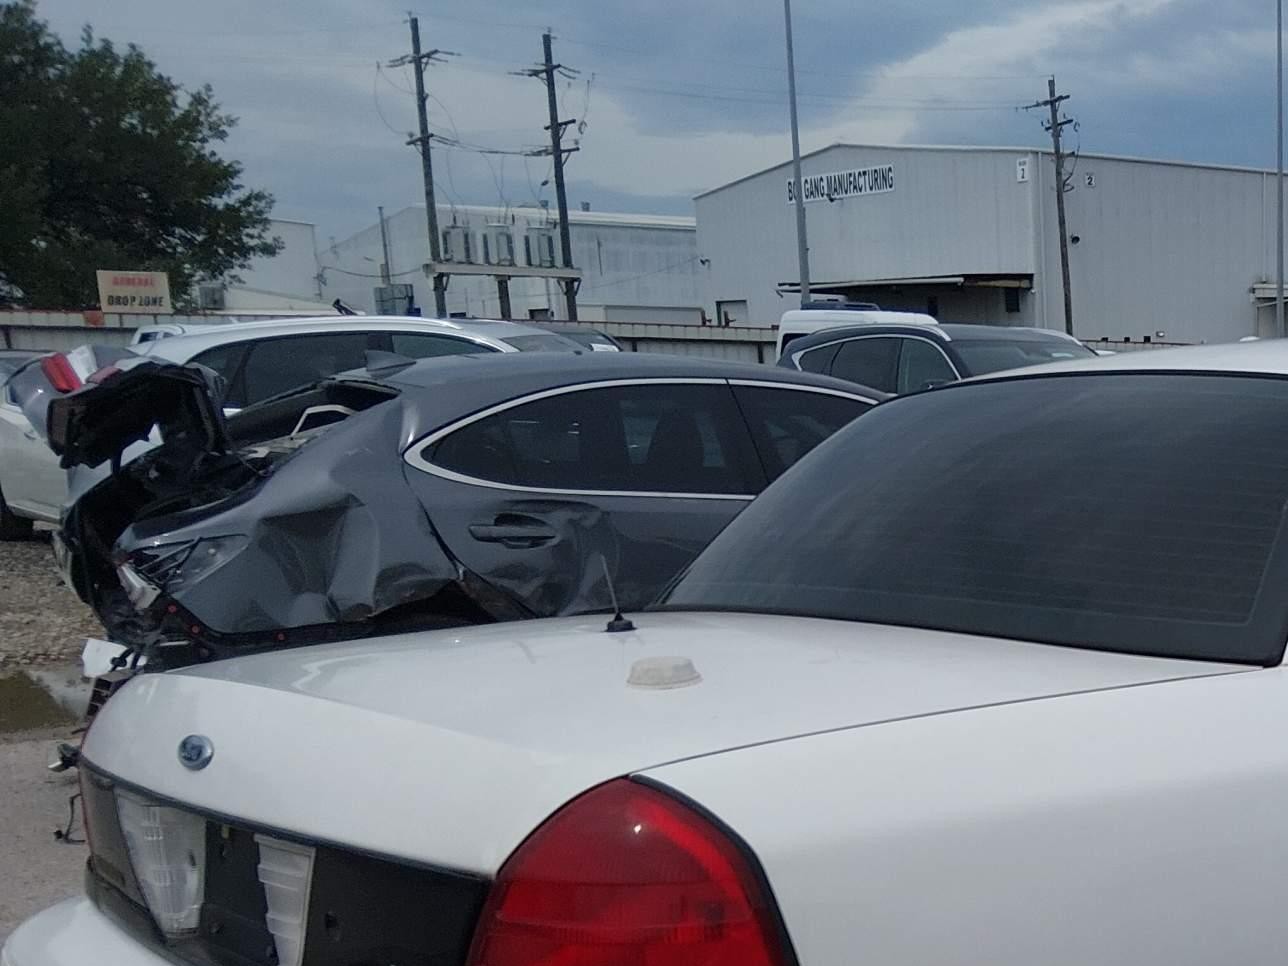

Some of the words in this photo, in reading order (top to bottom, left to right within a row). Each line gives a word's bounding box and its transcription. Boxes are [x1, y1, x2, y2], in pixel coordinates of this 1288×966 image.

[803, 177, 825, 200] GANG
[826, 166, 893, 197] MANUFACTURING
[1087, 175, 1093, 186] 2
[107, 295, 136, 306] DROP
[138, 295, 164, 307] ZONE
